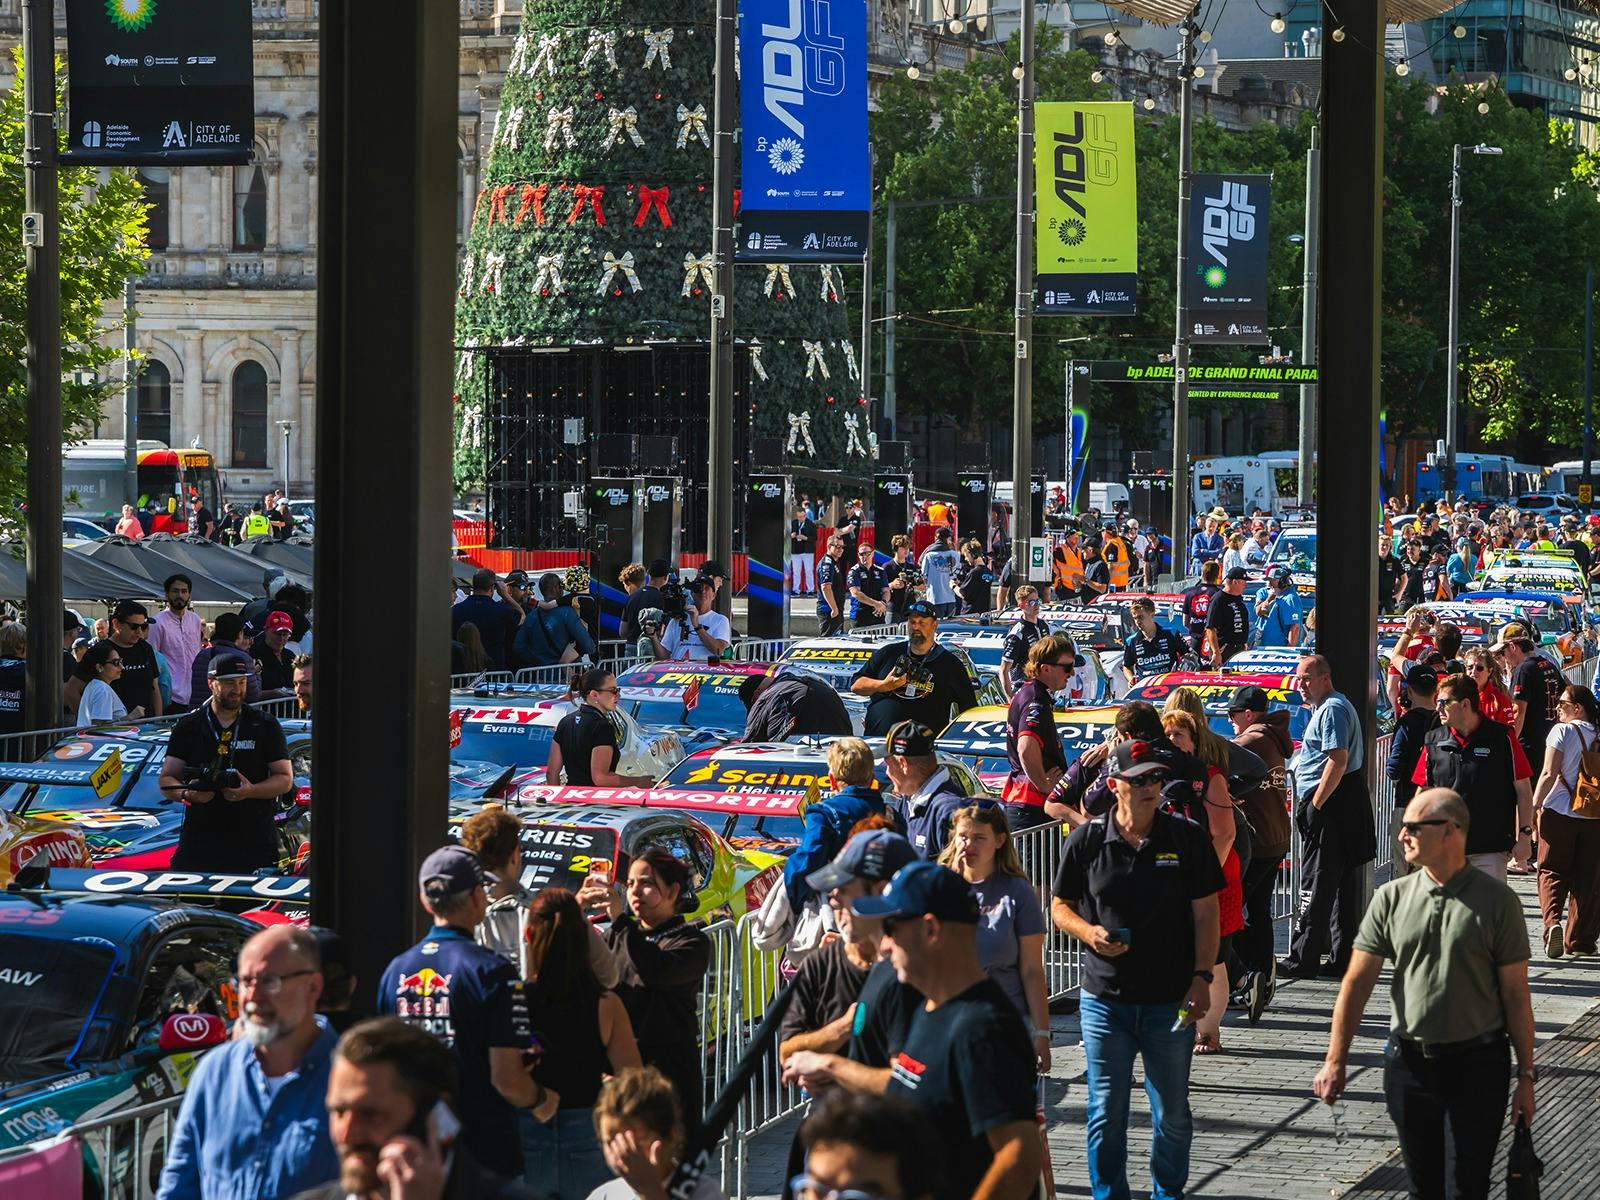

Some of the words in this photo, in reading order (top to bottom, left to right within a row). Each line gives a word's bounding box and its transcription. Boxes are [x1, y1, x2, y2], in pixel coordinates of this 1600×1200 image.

[196, 125, 216, 134] CITY
[219, 125, 231, 134] OF
[196, 134, 240, 143] ADELAIDE
[1085, 112, 1118, 186] GF
[1054, 111, 1086, 219] ADL
[1229, 183, 1256, 241] GF
[1202, 181, 1231, 267] ADL
[1127, 366, 1144, 380] bp
[1145, 367, 1204, 380] ADELDE
[1205, 367, 1248, 380] GRAND
[1250, 368, 1283, 380] FINAL
[1218, 391, 1251, 399] EXPERIENCE
[1137, 653, 1171, 666] Bendix
[482, 724, 526, 735] Evans
[88, 743, 167, 763] Bell
[96, 770, 112, 791] JAX
[563, 788, 796, 809] KENWORTH
[84, 871, 310, 898] OPTU
